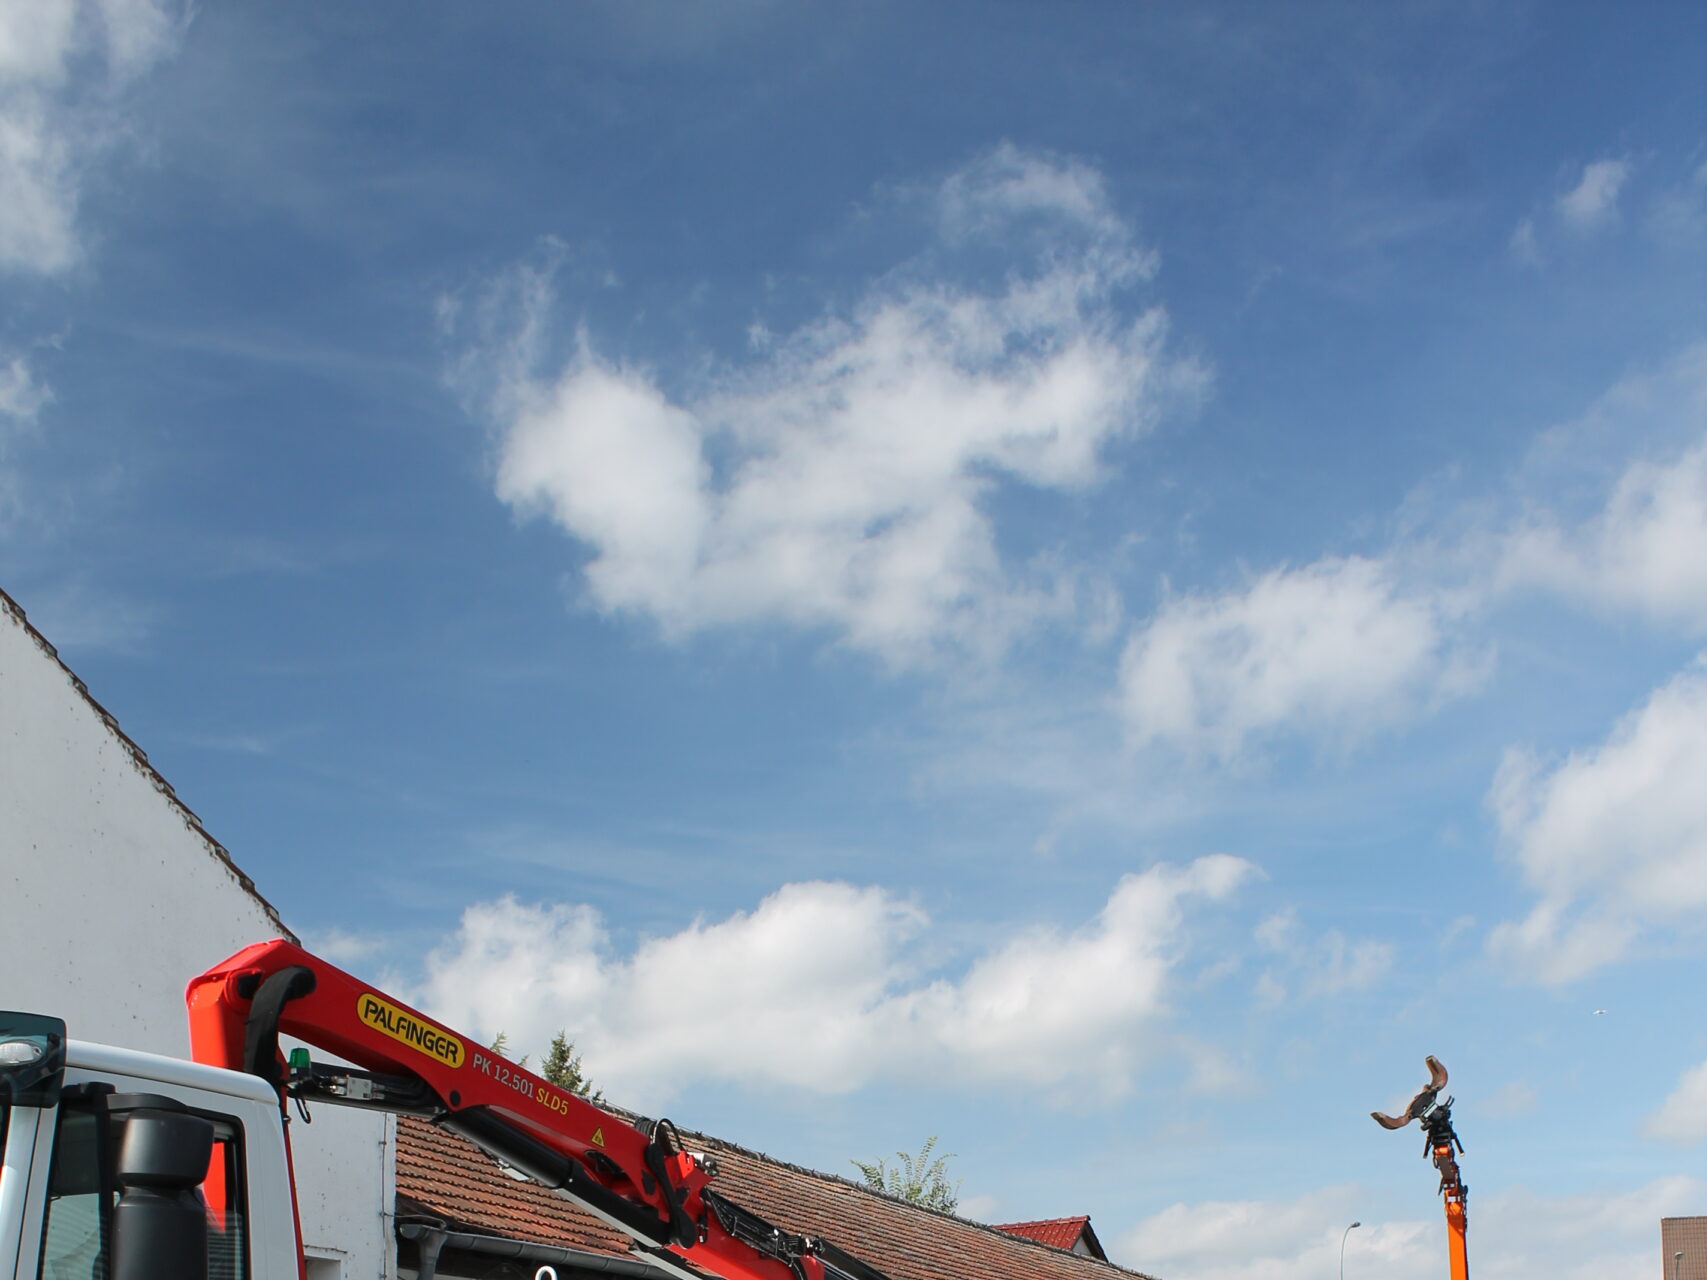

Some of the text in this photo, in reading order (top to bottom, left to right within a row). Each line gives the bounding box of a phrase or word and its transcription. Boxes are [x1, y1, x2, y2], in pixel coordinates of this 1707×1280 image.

[363, 998, 459, 1064] PALFINGER
[473, 1052, 569, 1116] PK 12.501 SLD5
